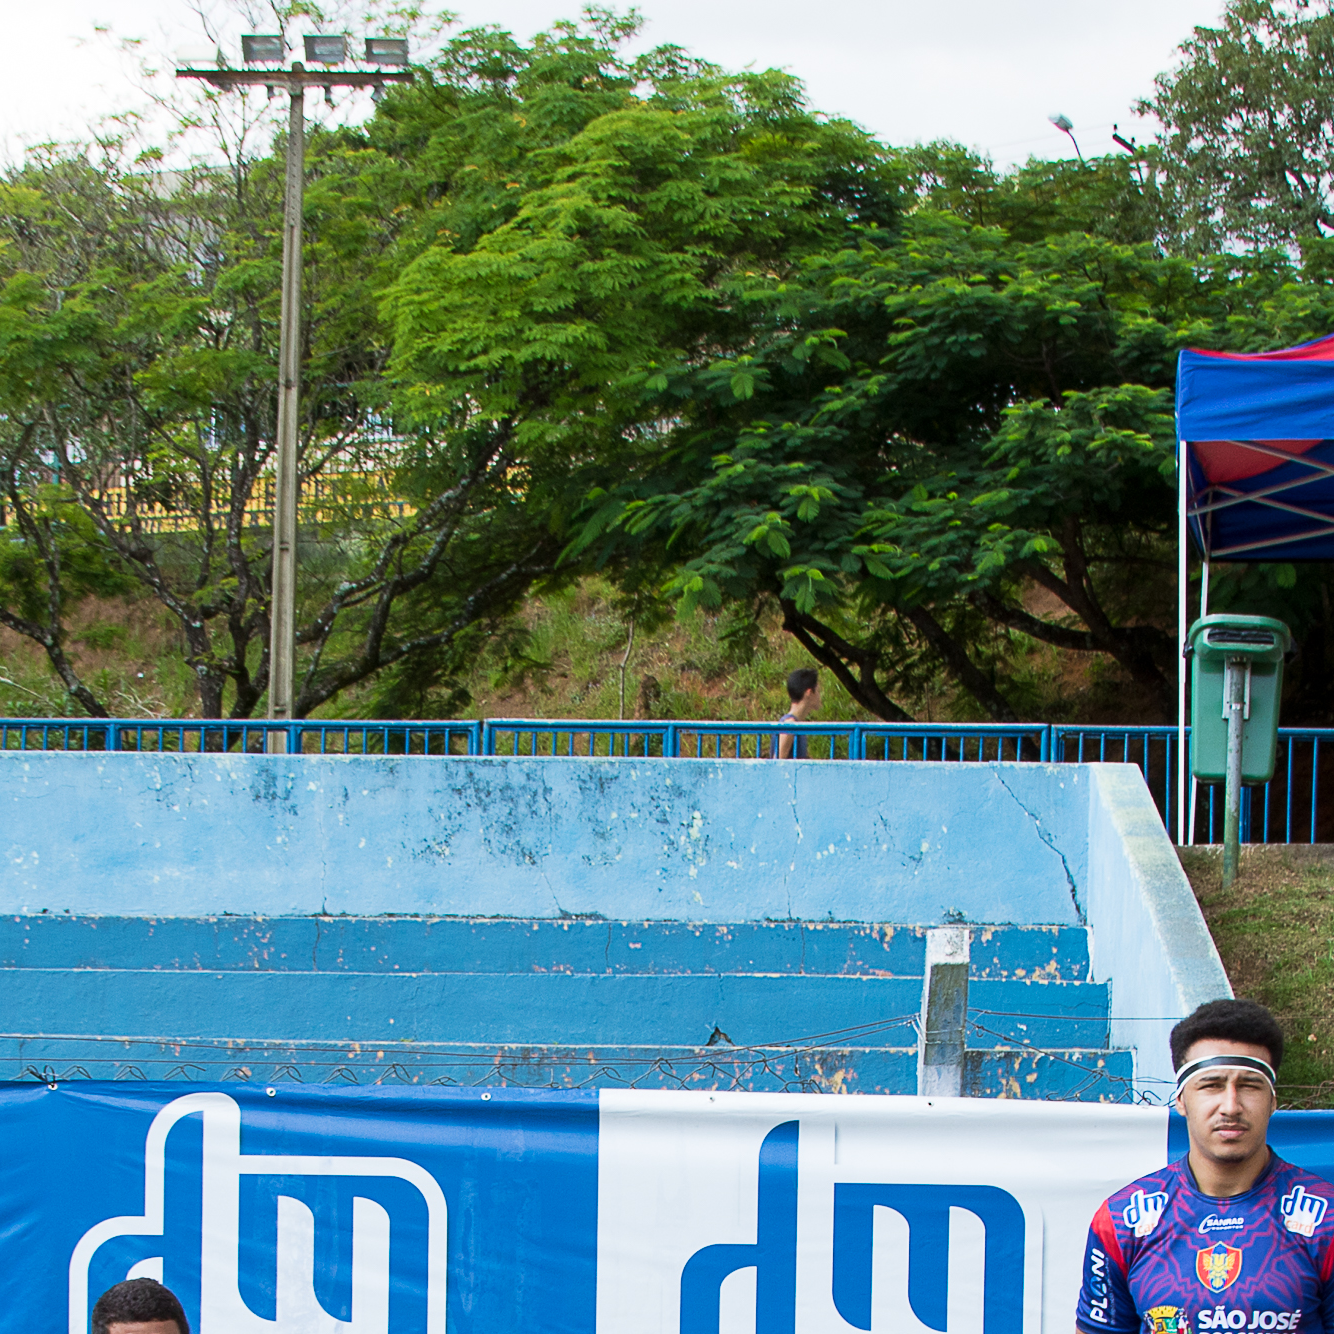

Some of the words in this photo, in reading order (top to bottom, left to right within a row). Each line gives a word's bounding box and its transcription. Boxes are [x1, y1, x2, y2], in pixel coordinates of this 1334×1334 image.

[1123, 1190, 1168, 1228] dm
[1206, 1216, 1245, 1228] SANRAD
[1281, 1185, 1328, 1228] dm
[1285, 1217, 1315, 1236] card
[1089, 1248, 1106, 1324] PLANI
[1198, 1305, 1247, 1330] SÃO
[1247, 1309, 1302, 1332] JOSÉ
